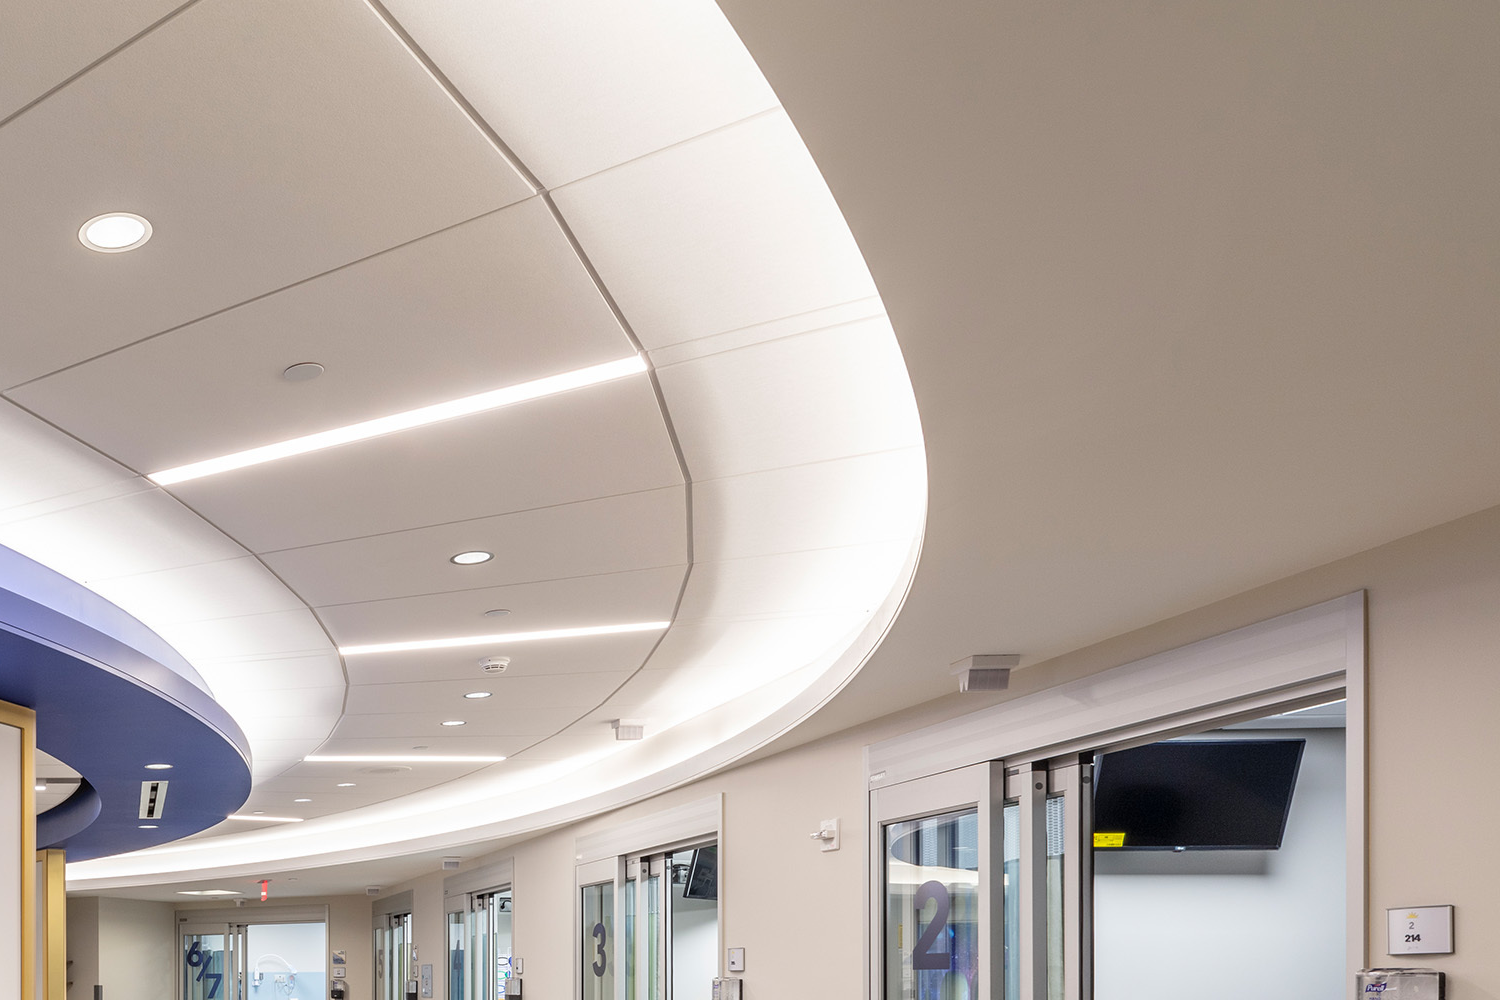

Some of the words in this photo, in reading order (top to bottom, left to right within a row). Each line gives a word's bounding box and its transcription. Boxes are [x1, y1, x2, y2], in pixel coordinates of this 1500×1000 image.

[913, 880, 950, 970] 2
[1404, 933, 1421, 943] 214
[1408, 921, 1415, 930] 2
[592, 922, 607, 977] 3
